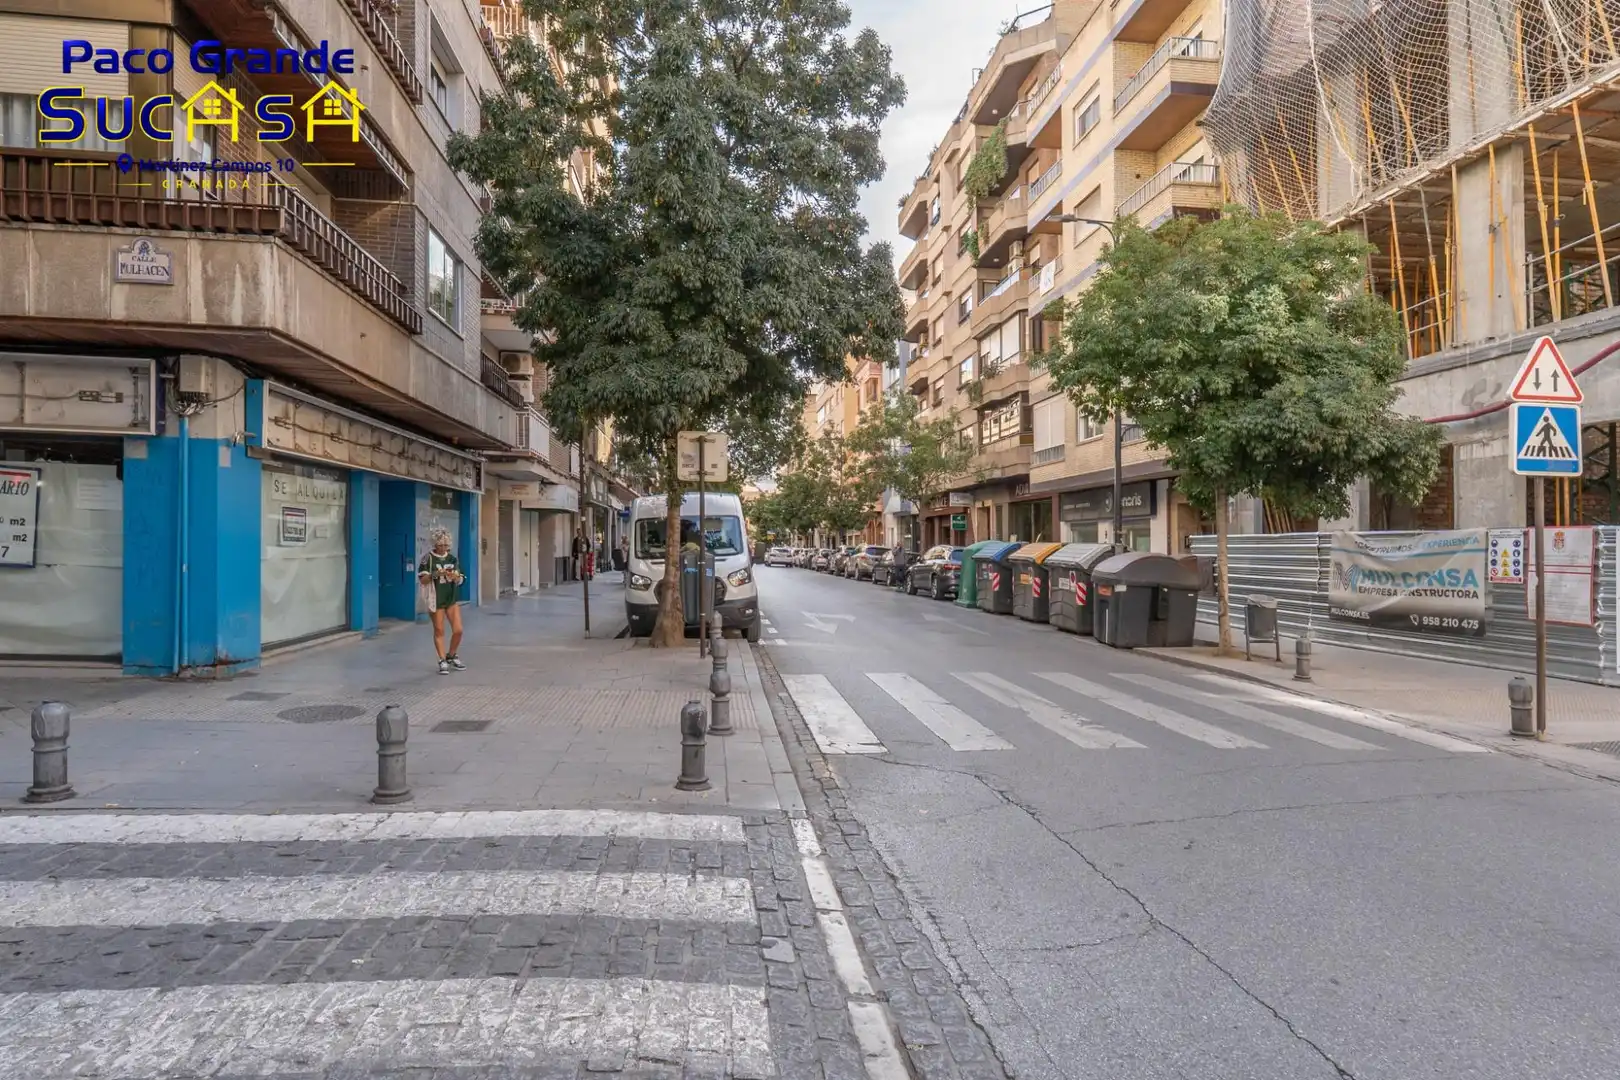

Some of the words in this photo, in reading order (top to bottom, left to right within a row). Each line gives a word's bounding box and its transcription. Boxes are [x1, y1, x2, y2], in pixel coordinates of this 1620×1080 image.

[131, 255, 157, 263] CALLE
[274, 479, 287, 495] SE
[296, 483, 344, 500] ALQUILA
[10, 518, 26, 526] m2
[13, 534, 28, 542] m2
[1360, 568, 1480, 588] MULCONSA
[1358, 586, 1398, 597] EMPRESA
[1422, 616, 1440, 626] 958
[1442, 617, 1459, 628] 210
[1461, 619, 1479, 630] 475
